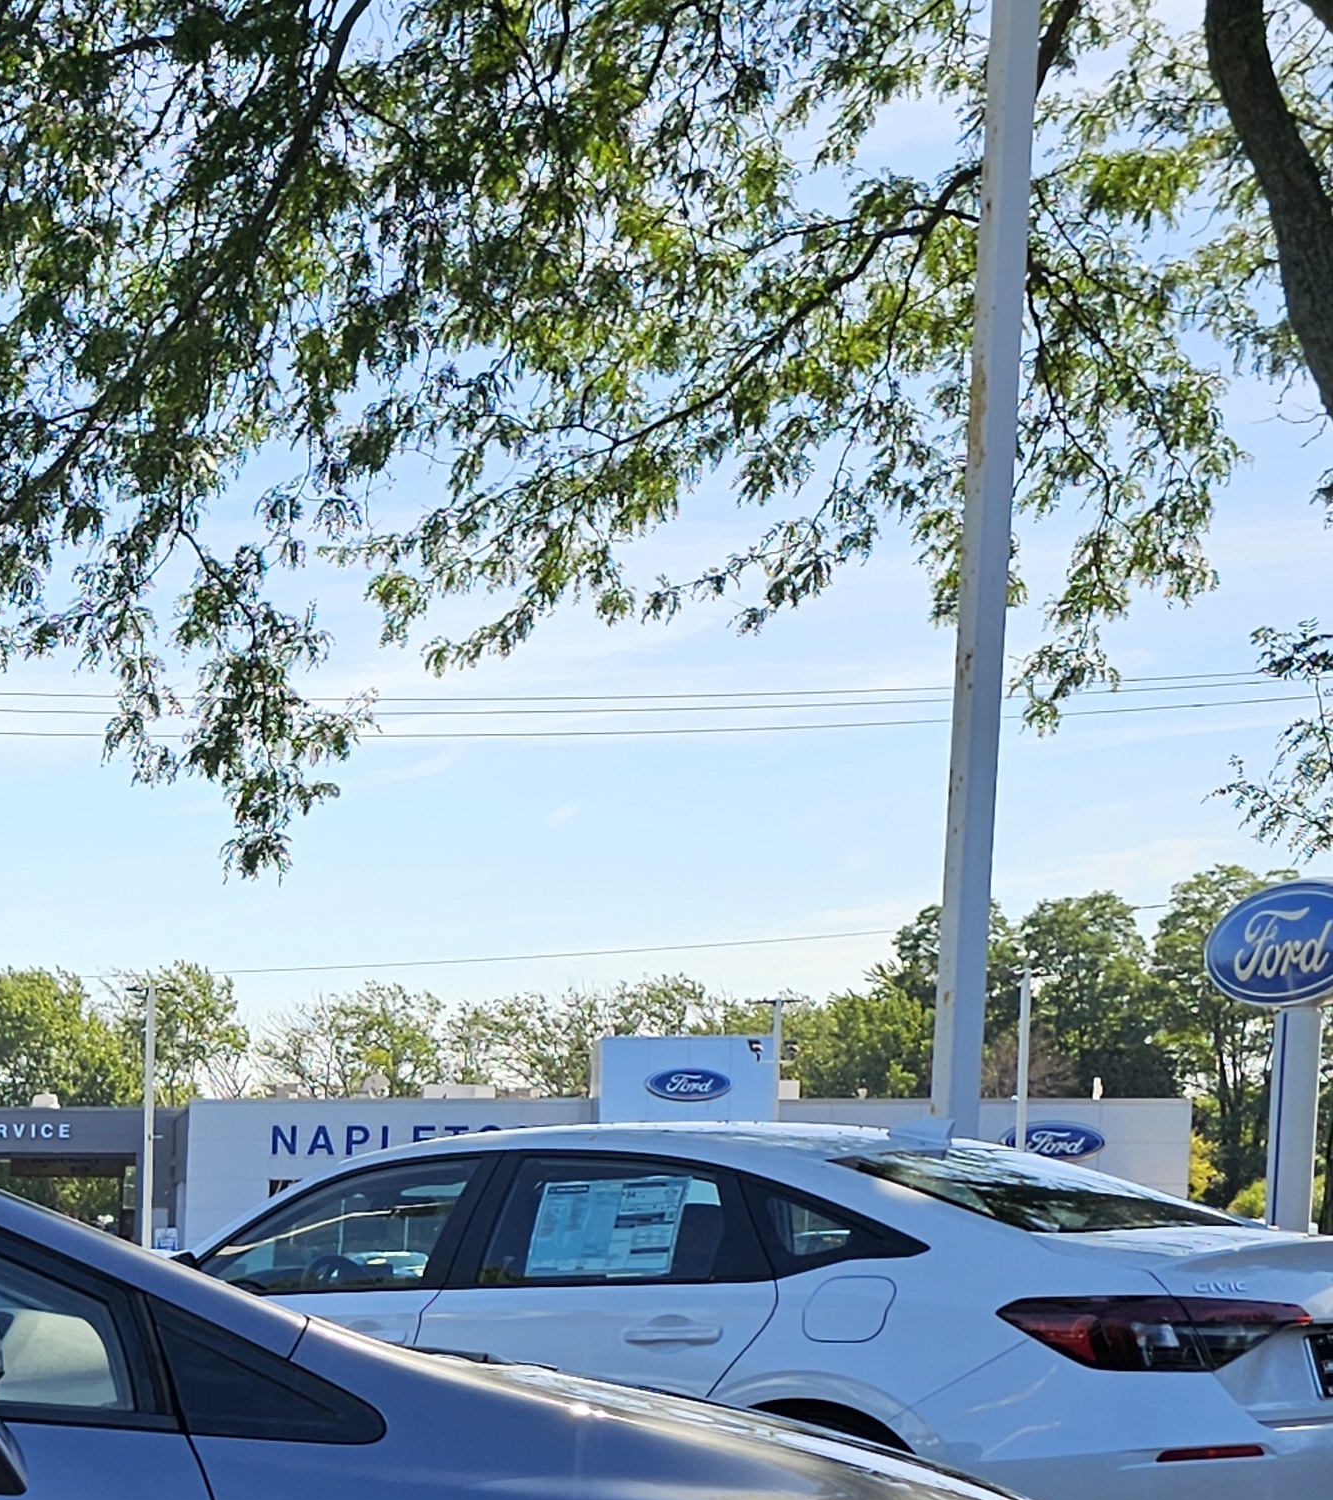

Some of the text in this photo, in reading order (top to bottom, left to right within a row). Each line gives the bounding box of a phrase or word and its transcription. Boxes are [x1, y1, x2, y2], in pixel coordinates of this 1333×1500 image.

[1234, 906, 1333, 982] Ford
[666, 1073, 714, 1092] Ford
[1026, 1130, 1086, 1154] Ford
[1194, 1280, 1249, 1294] CIVIC
